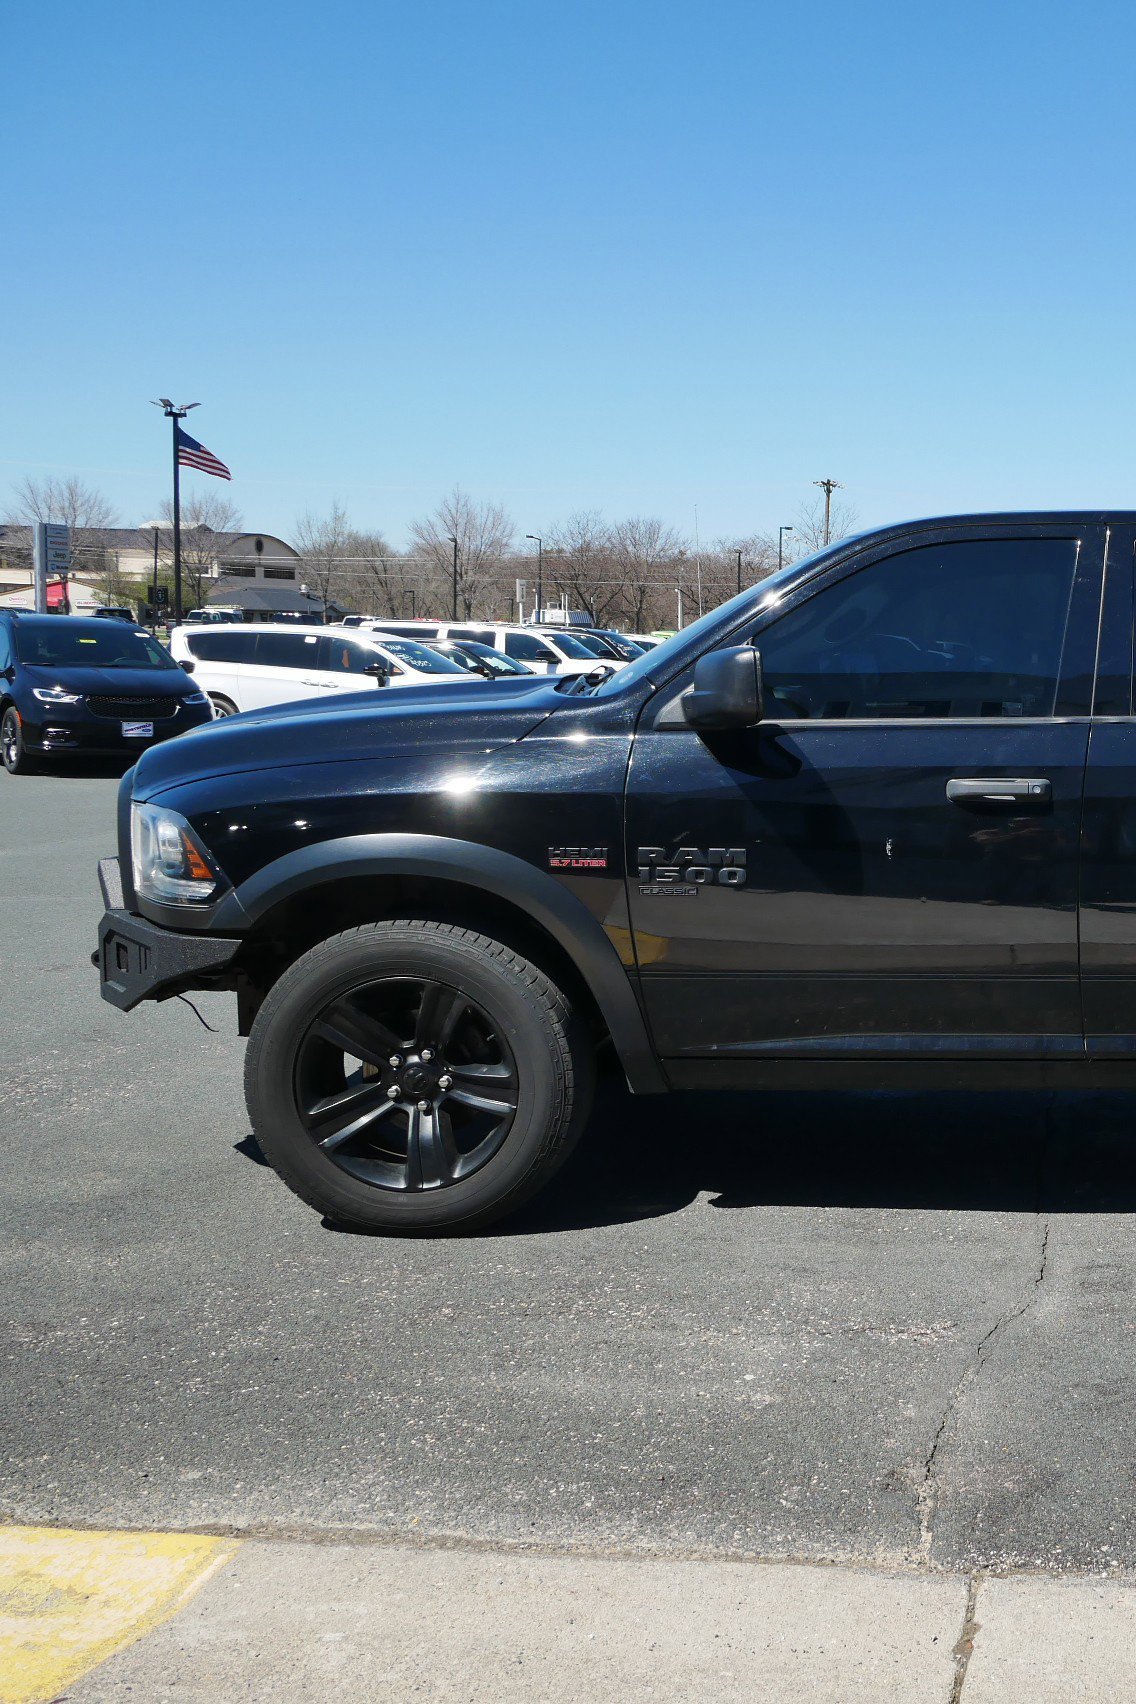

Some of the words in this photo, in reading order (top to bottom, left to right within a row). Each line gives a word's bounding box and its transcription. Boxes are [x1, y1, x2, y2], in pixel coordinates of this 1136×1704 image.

[548, 847, 608, 859] HEMI
[638, 847, 746, 864] RAM
[638, 867, 746, 884] 1500
[640, 887, 698, 895] CLASSIC
